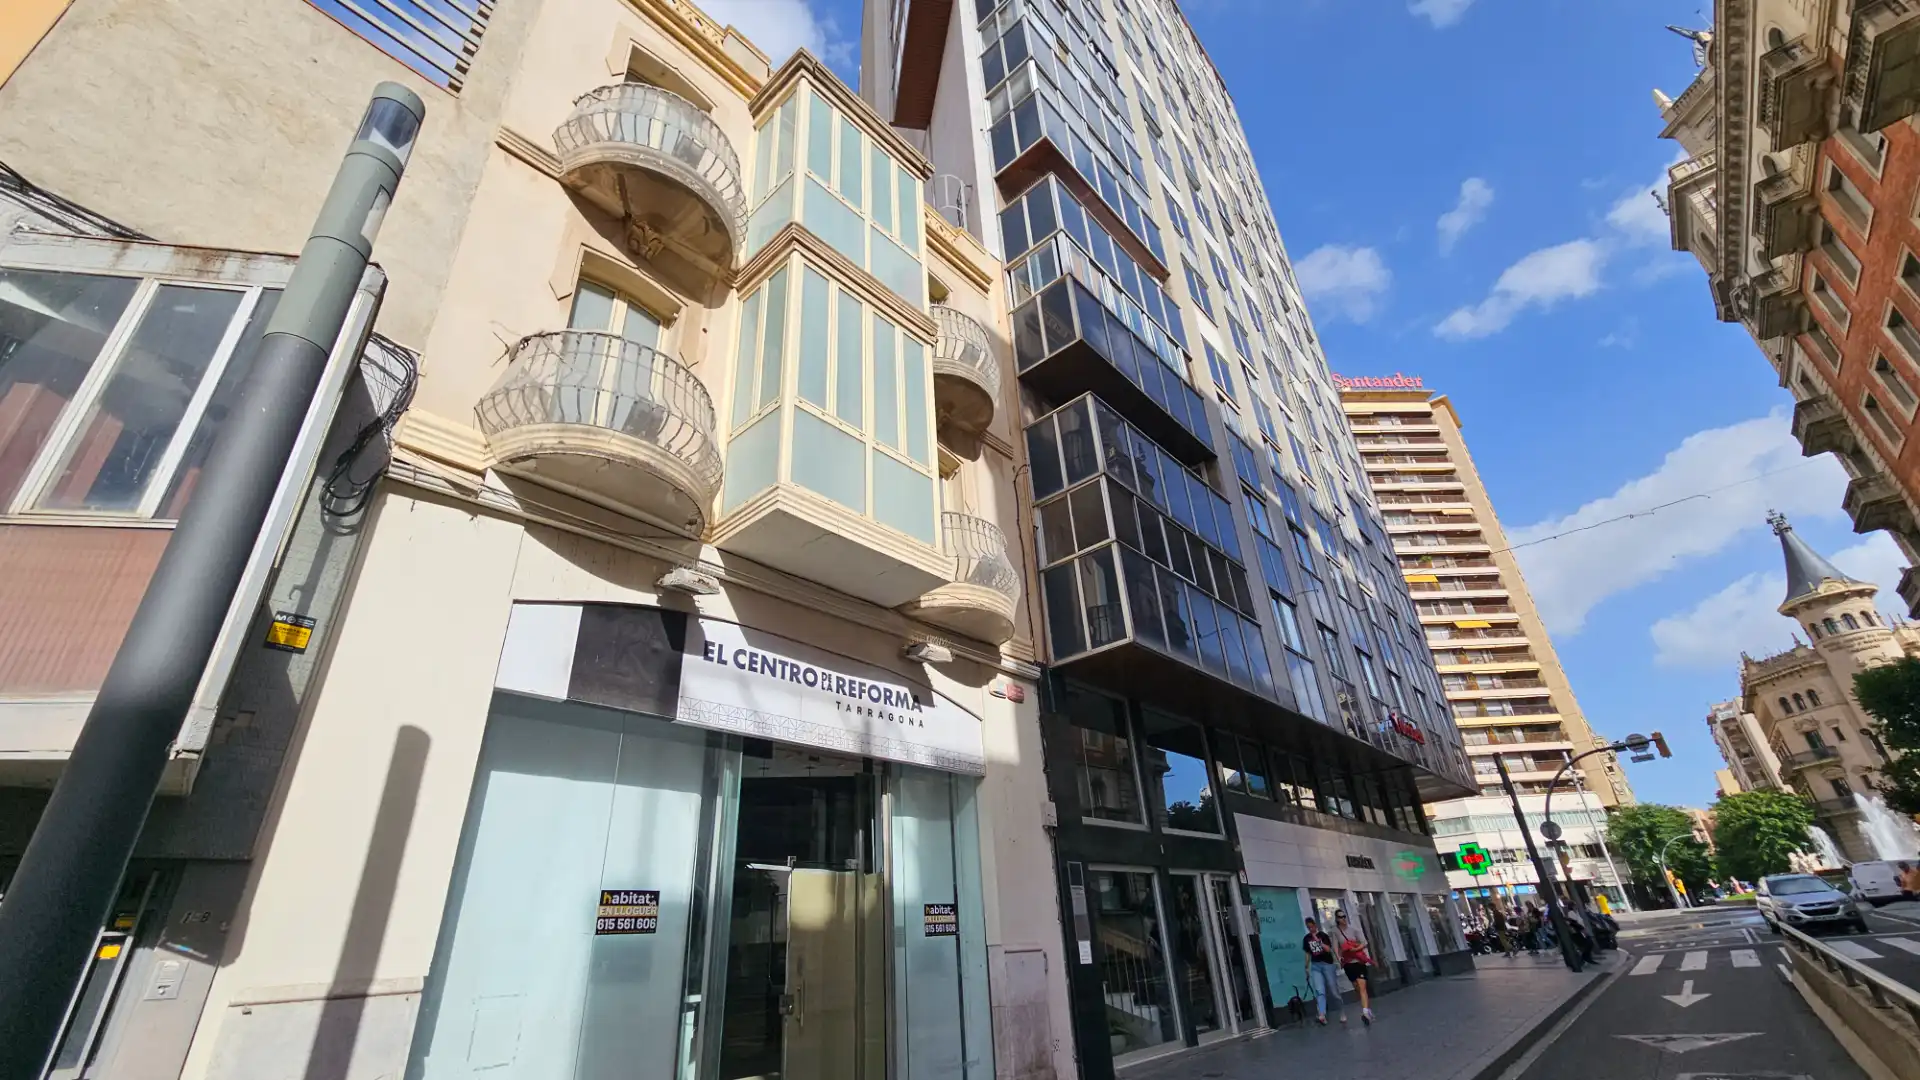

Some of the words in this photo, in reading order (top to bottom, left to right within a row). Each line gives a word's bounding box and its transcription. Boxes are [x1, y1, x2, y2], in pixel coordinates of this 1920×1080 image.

[1332, 370, 1423, 388] Santander
[703, 639, 728, 666] EL
[733, 648, 818, 688] CENTRO
[821, 671, 832, 683] DE
[821, 681, 833, 693] LA
[835, 675, 923, 713] REFORMA
[836, 701, 924, 728] TARRAGONA
[603, 891, 651, 905] habitat
[600, 906, 613, 916] EN
[614, 906, 657, 915] LLOGUER
[925, 905, 953, 915] habitat
[597, 918, 616, 930] 615
[636, 918, 657, 929] 606
